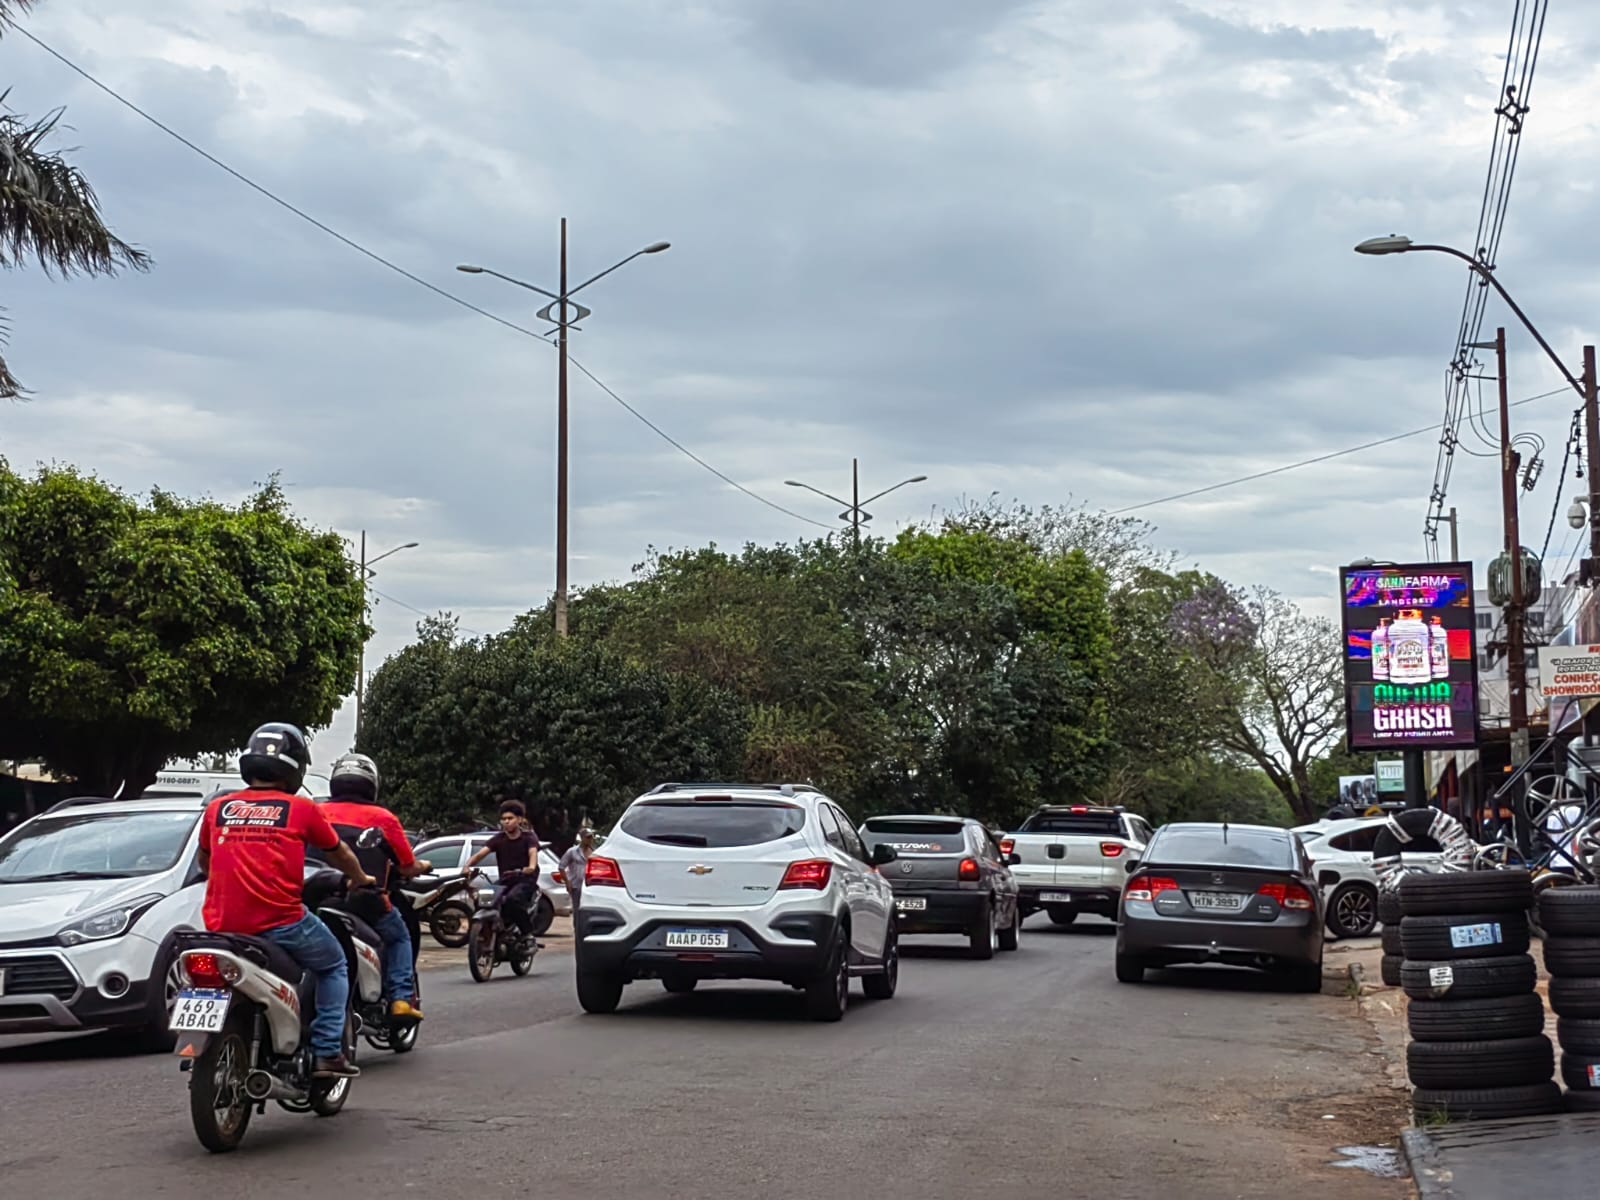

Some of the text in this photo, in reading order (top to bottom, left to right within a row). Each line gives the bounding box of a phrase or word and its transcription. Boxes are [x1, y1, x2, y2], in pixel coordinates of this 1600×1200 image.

[1554, 673, 1600, 684] CONHEÇ
[223, 801, 284, 820] TOTAL
[668, 933, 721, 946] AAAP 055
[182, 999, 215, 1013] 469
[175, 1013, 218, 1029] ABAC
